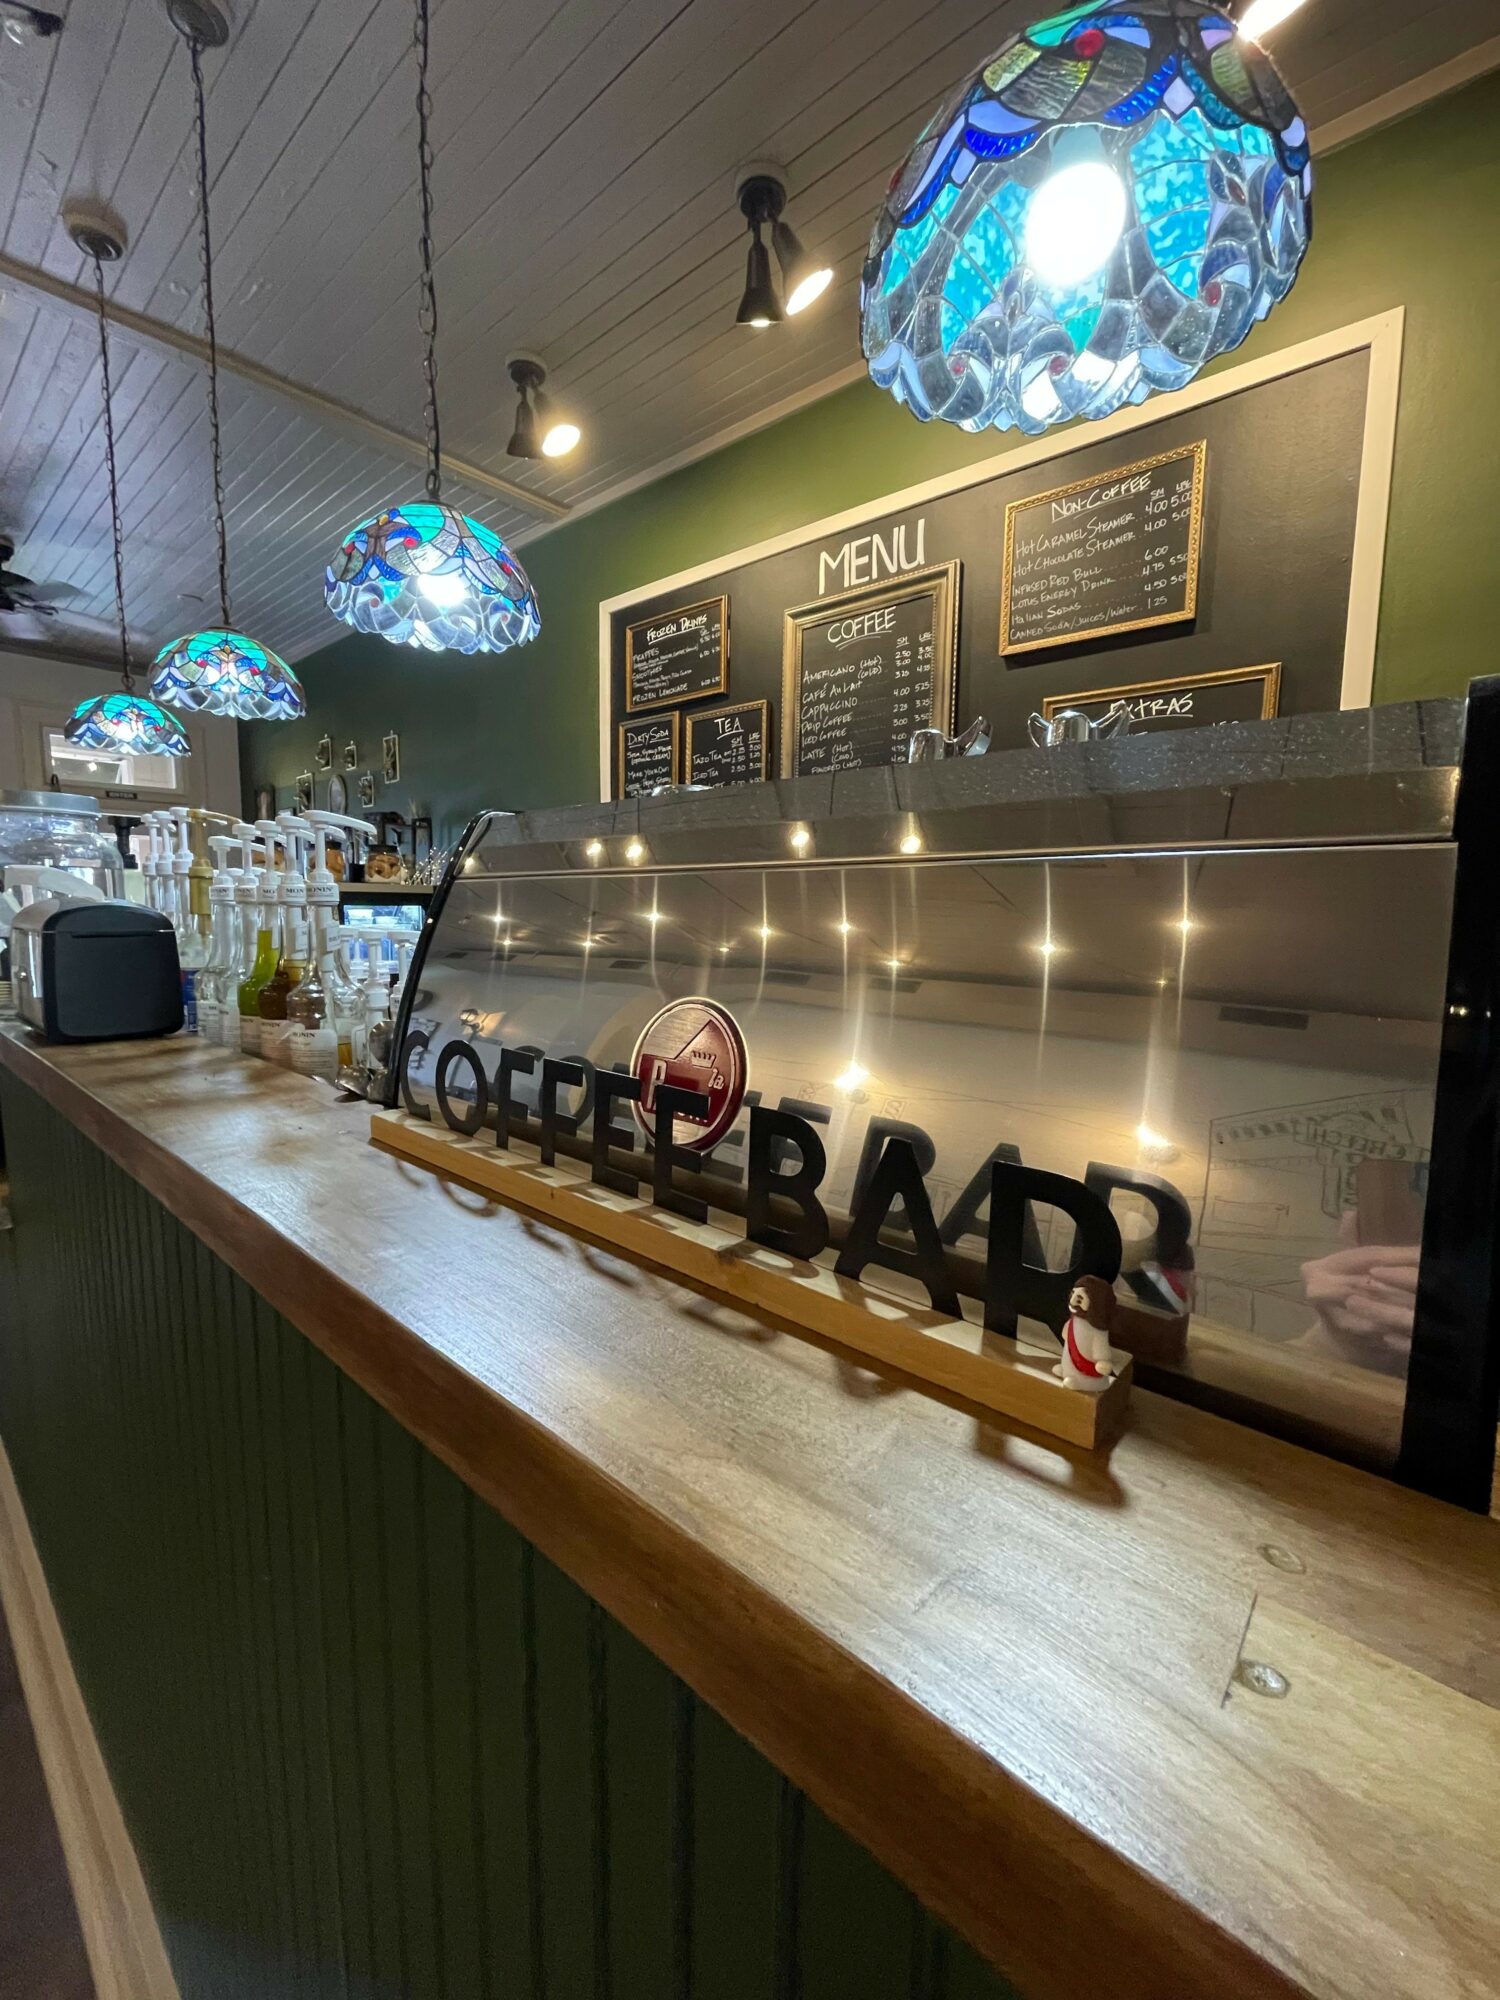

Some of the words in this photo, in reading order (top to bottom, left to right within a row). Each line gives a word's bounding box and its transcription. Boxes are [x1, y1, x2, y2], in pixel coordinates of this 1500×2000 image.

[1036, 529, 1088, 551] CARAMEL
[818, 518, 926, 596] MENU
[1034, 547, 1085, 570] CHOCOLATE
[1049, 575, 1070, 588] RED
[1072, 567, 1103, 582] BULL
[646, 622, 677, 642] FROZEN
[827, 605, 897, 643] COFFEE
[803, 665, 856, 685] AMERICANO
[801, 697, 858, 721] CAPPUCCINO
[714, 717, 743, 734] TEA
[823, 711, 854, 729] COFFEE
[819, 727, 847, 742] COFFEE
[801, 746, 827, 762] LATTE
[398, 1029, 710, 1224] COFFEE
[746, 1105, 1122, 1353] BAR
